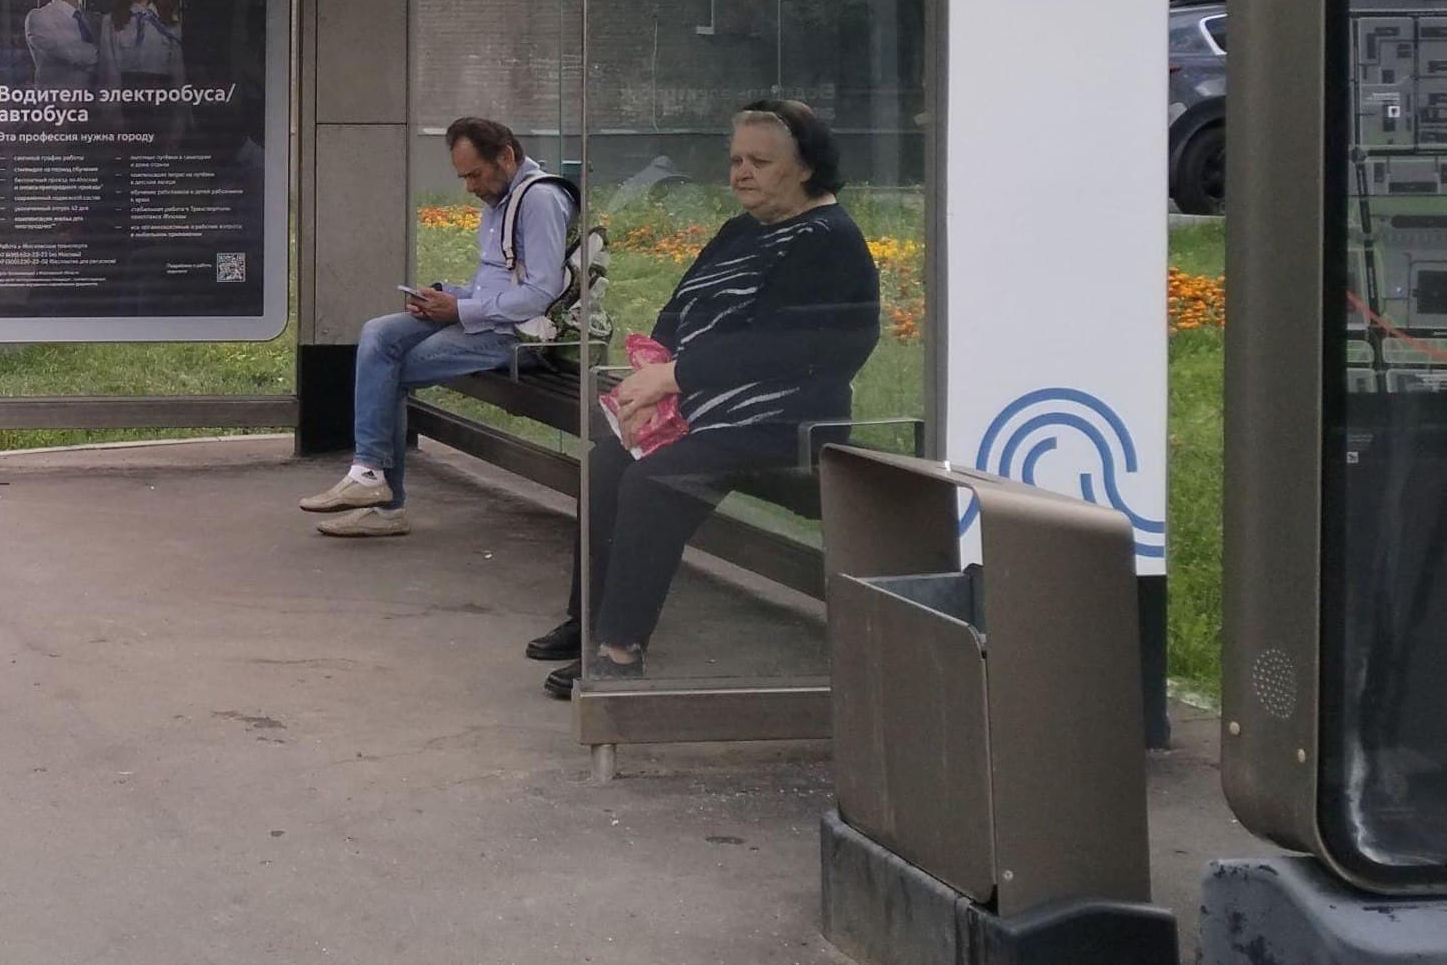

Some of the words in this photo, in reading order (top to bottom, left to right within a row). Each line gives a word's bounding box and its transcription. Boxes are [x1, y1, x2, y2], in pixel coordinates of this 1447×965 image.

[99, 83, 235, 105] электробуса/
[19, 131, 78, 144] профессия
[80, 133, 114, 144] нужна
[117, 133, 155, 144] городу
